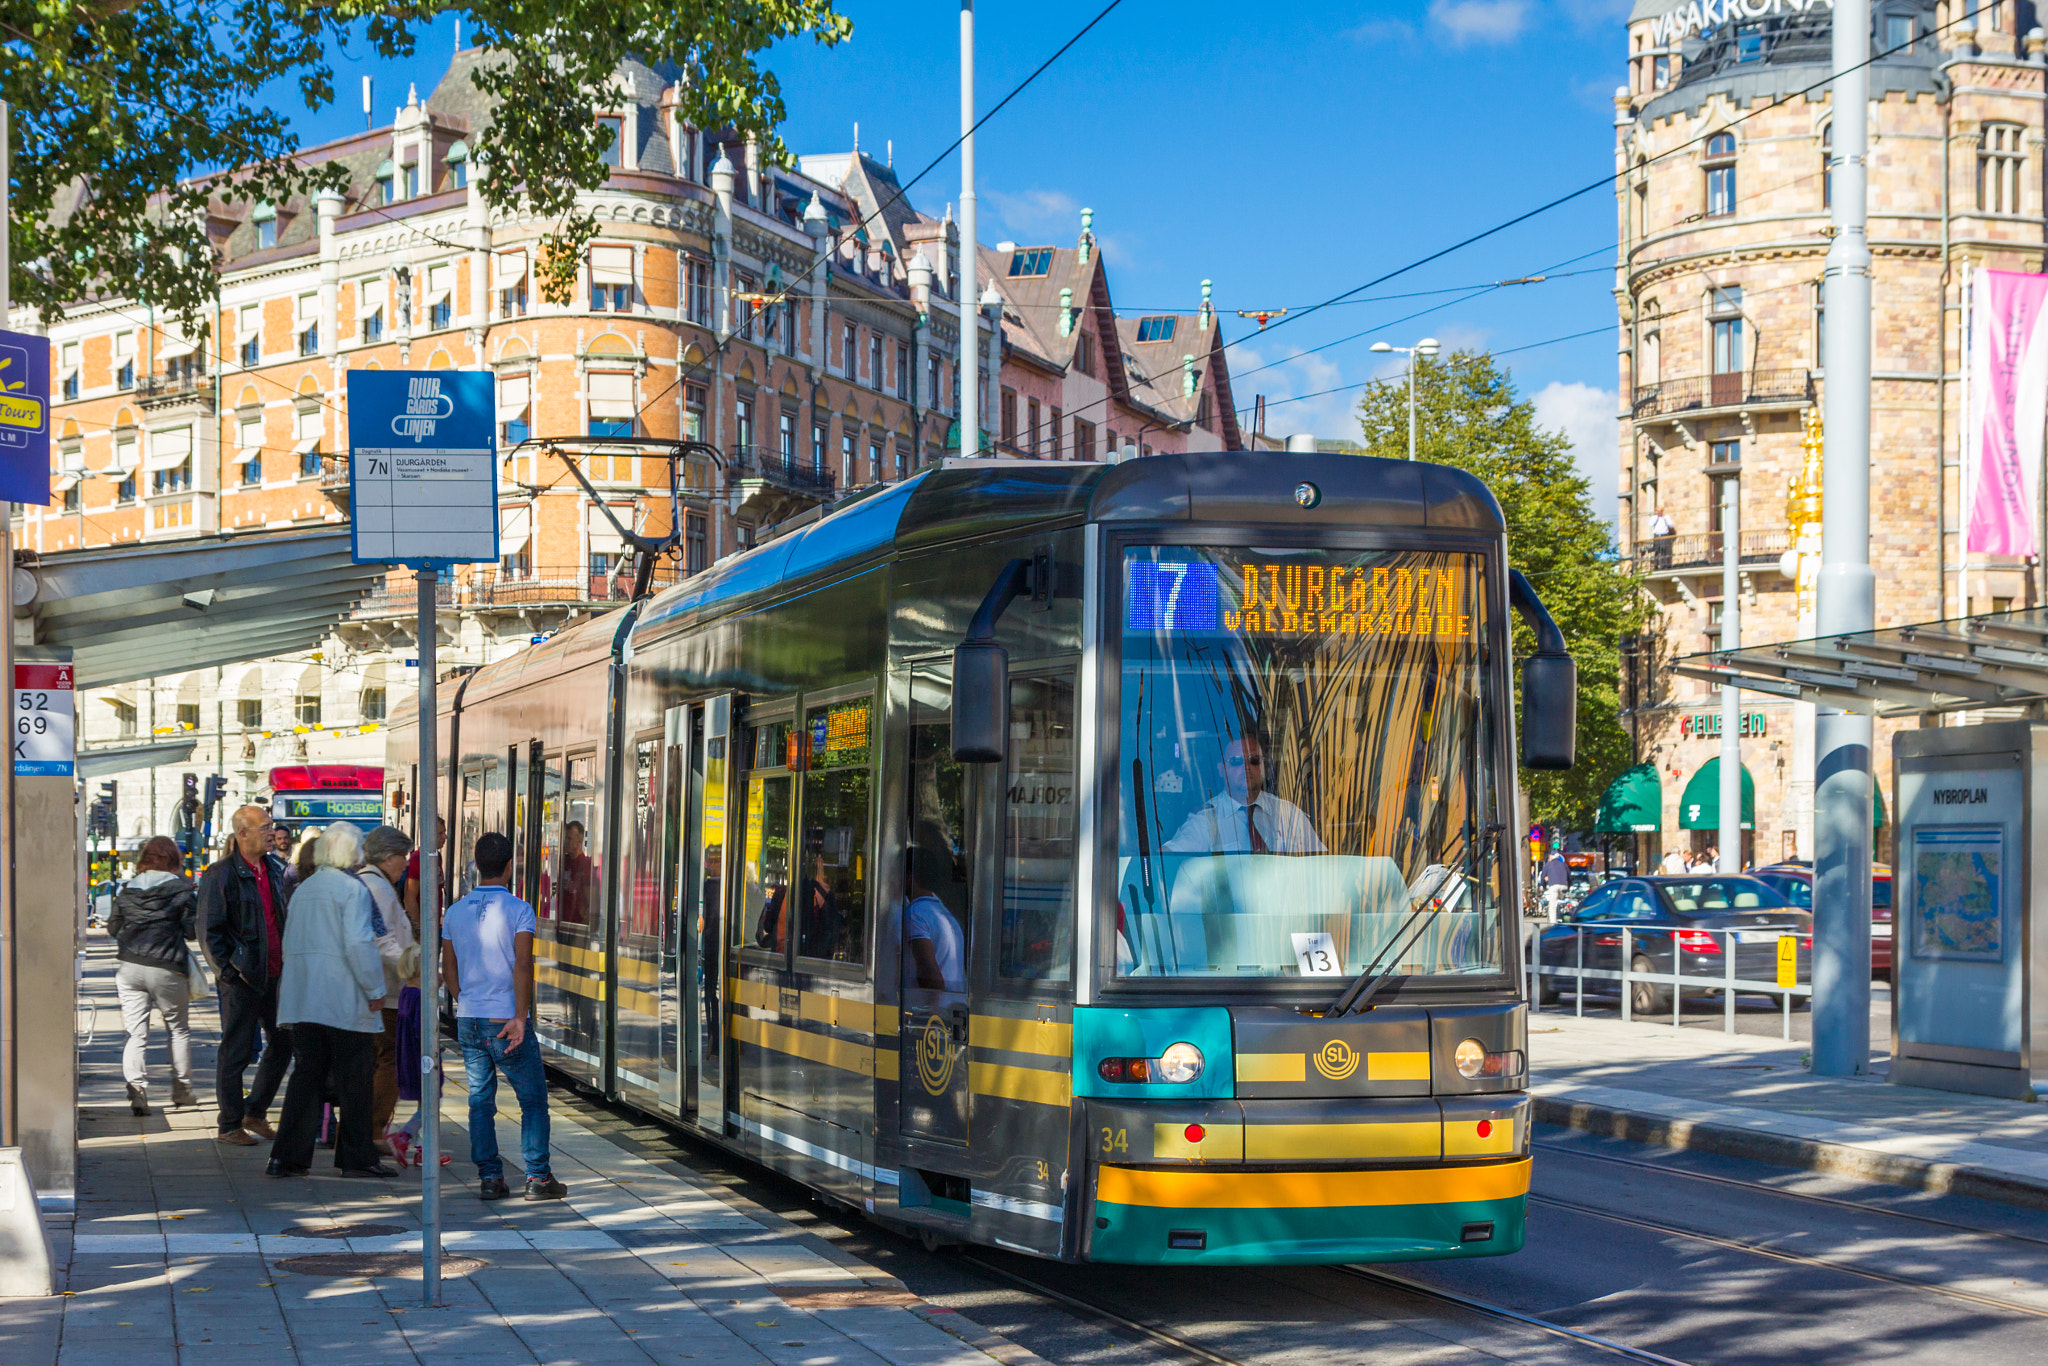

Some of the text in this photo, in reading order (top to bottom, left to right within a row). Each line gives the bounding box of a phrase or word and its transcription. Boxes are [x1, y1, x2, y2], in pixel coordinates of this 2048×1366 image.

[408, 377, 441, 400] DJUR
[404, 419, 436, 443] LINJEN
[396, 458, 447, 466] DJURGÅRDEN
[1158, 562, 1455, 630] 7 DJURGÅRDEN
[1224, 610, 1470, 636] WALDEMARSUDDE
[59, 671, 68, 680] A
[20, 692, 48, 711] 52
[18, 716, 47, 735] 69
[56, 764, 68, 772] 7N
[1933, 788, 1988, 805] NYBROPLAN
[293, 800, 383, 817] 76 Ropsten
[1303, 950, 1332, 972] 13
[926, 1030, 944, 1060] SL
[1101, 1127, 1128, 1153] 34
[1037, 1161, 1049, 1181] 34
